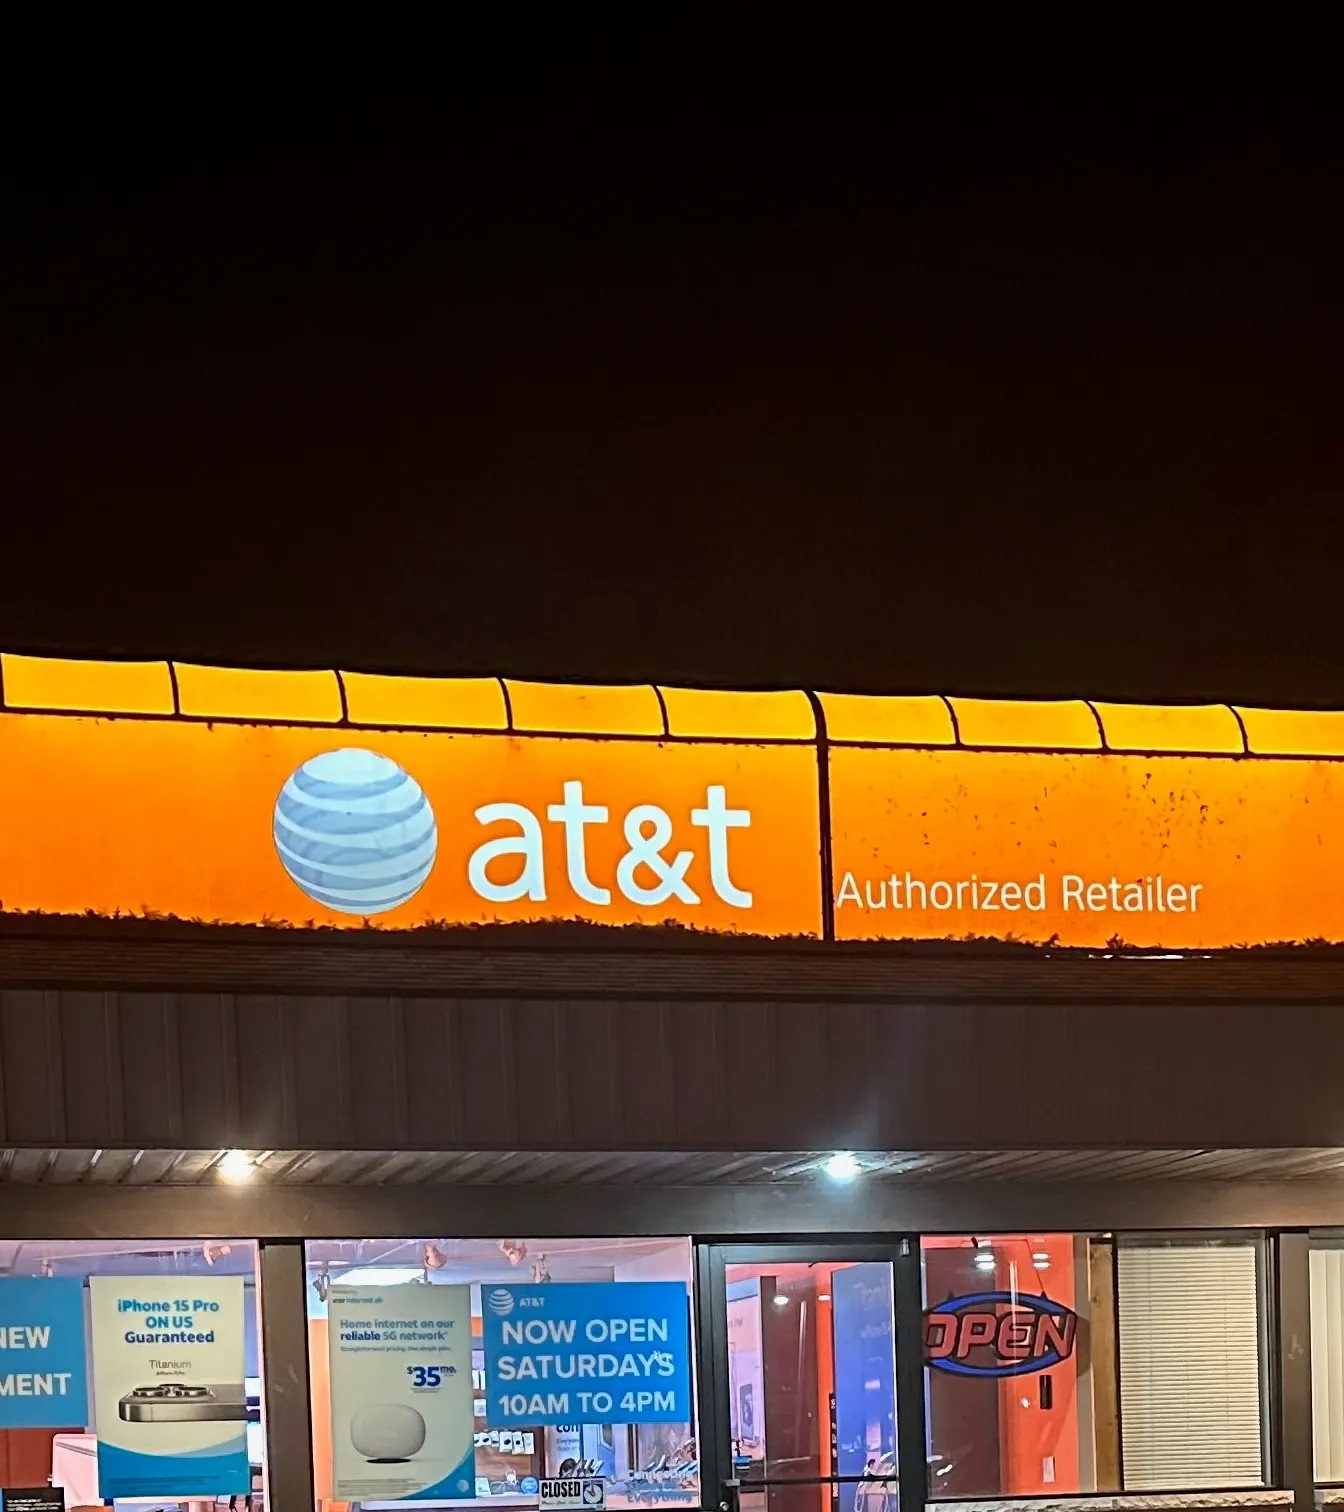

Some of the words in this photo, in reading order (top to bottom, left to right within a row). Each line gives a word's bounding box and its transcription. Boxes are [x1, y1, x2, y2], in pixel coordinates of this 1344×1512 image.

[836, 870, 1046, 913] Authorized
[1061, 873, 1203, 914] Retailer
[117, 1298, 171, 1314] iPhone
[175, 1300, 190, 1313] 15
[193, 1299, 220, 1312] Pro
[519, 1297, 545, 1307] AT&T
[145, 1316, 169, 1329] ON
[172, 1316, 193, 1328] US
[340, 1320, 372, 1329] Home
[420, 1320, 434, 1329] on
[436, 1320, 455, 1328] our
[124, 1330, 215, 1345] Guaranteed
[340, 1331, 381, 1340] reliable
[383, 1331, 397, 1340] 5G
[502, 1319, 576, 1345] NOW
[585, 1318, 668, 1343] OPEN
[923, 1311, 1077, 1359] OPEN
[499, 1393, 569, 1416] 10AM
[576, 1392, 613, 1413] TO
[620, 1391, 675, 1412] 4PM
[541, 1481, 581, 1498] CLOSED
